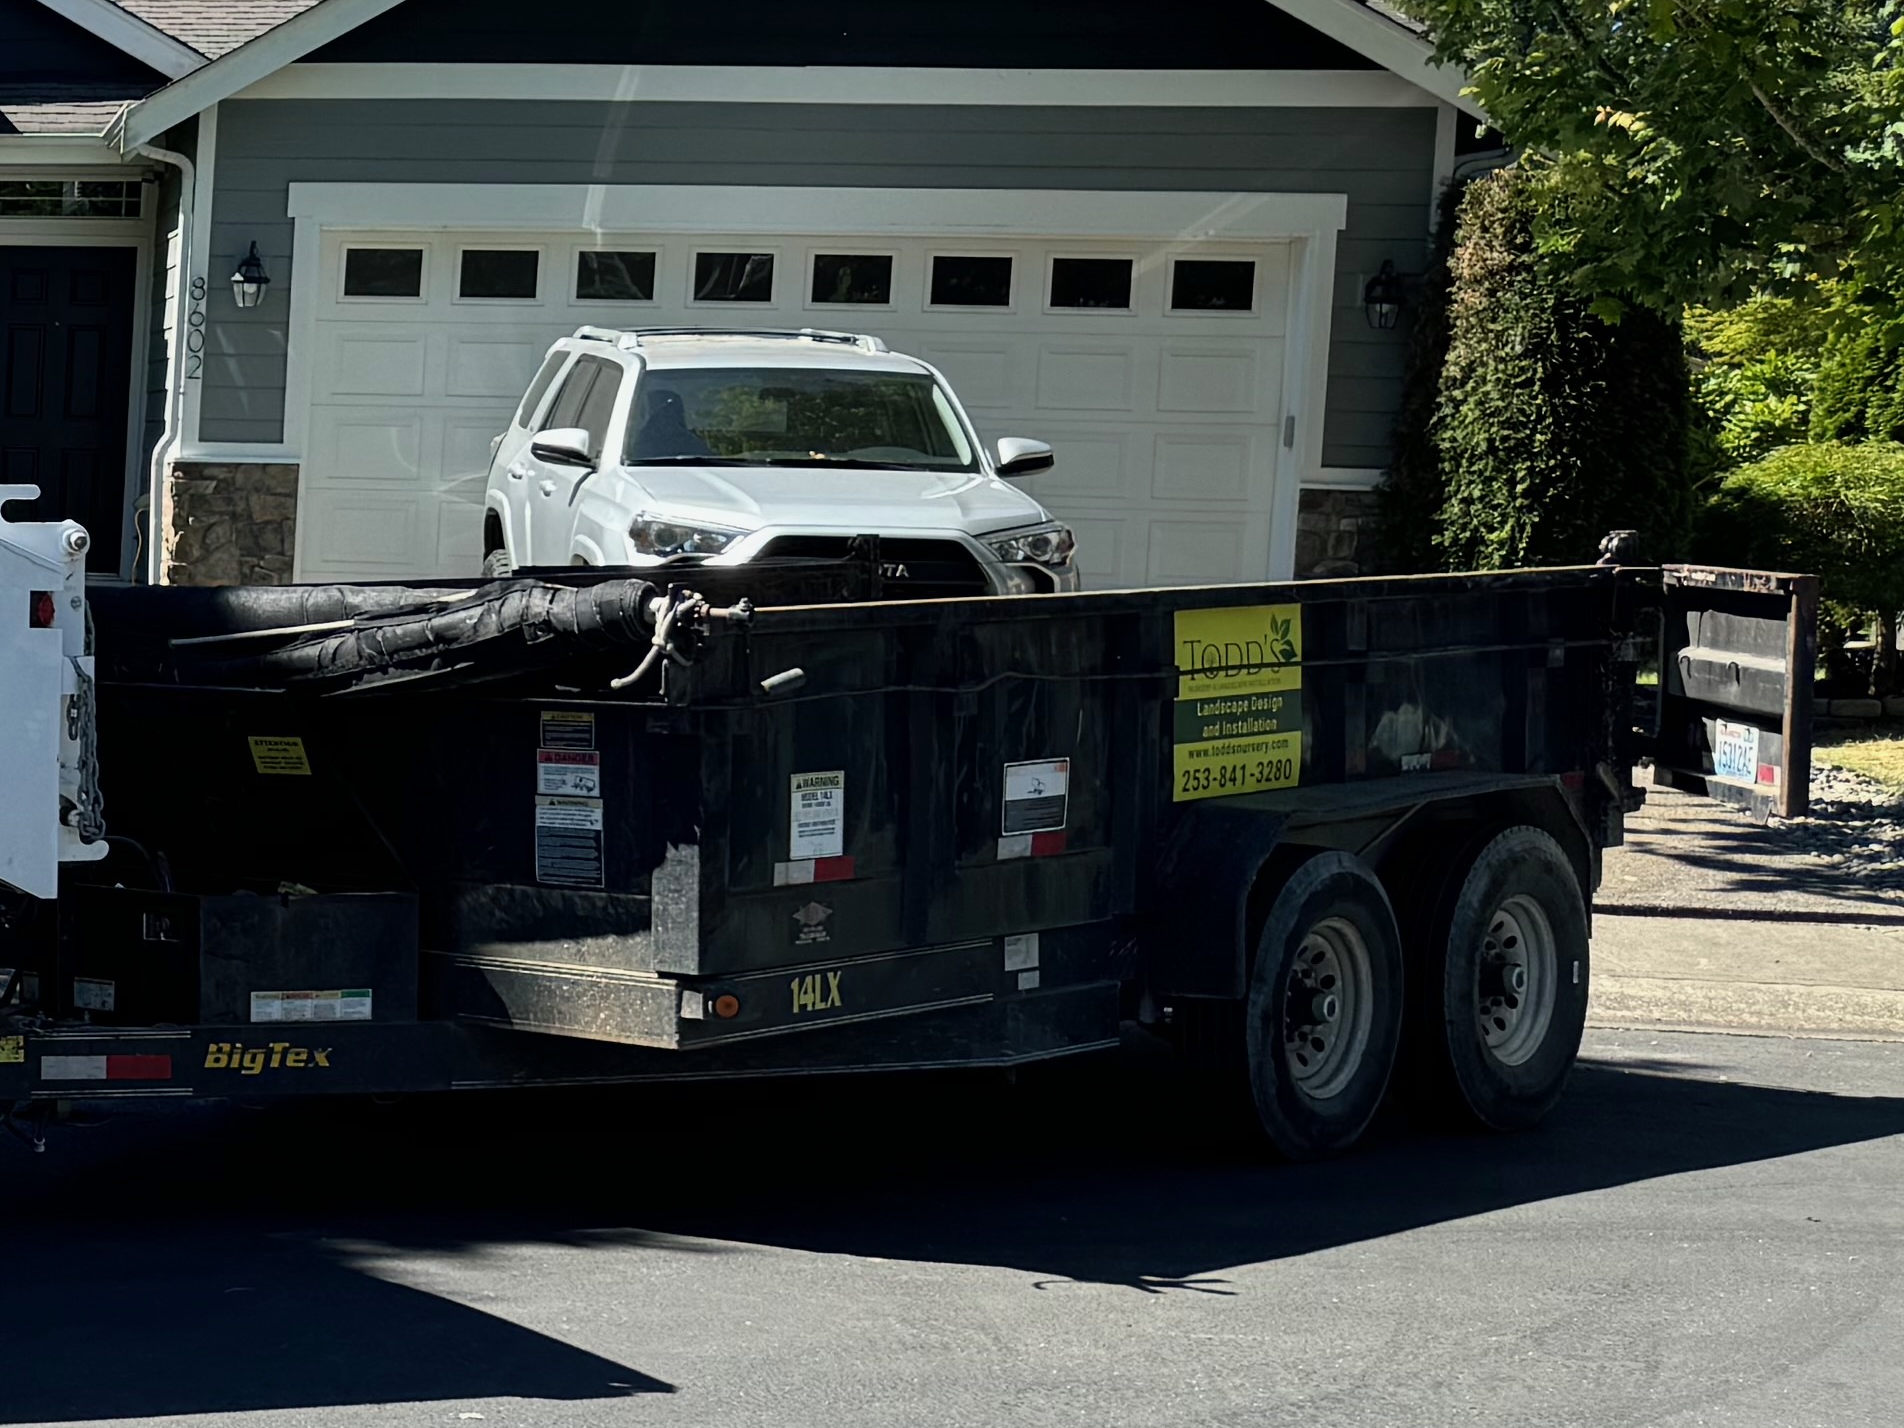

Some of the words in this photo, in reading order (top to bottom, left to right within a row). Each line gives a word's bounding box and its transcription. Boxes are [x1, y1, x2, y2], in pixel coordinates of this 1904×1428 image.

[186, 276, 206, 380] 8602
[1182, 633, 1281, 681] TODD'S
[1197, 697, 1249, 716] Landscape
[1251, 694, 1284, 712] Design
[1202, 721, 1220, 738] and
[1222, 717, 1278, 736] Installation
[1181, 757, 1293, 793] 253-841-3280
[791, 971, 842, 1013] 14LX
